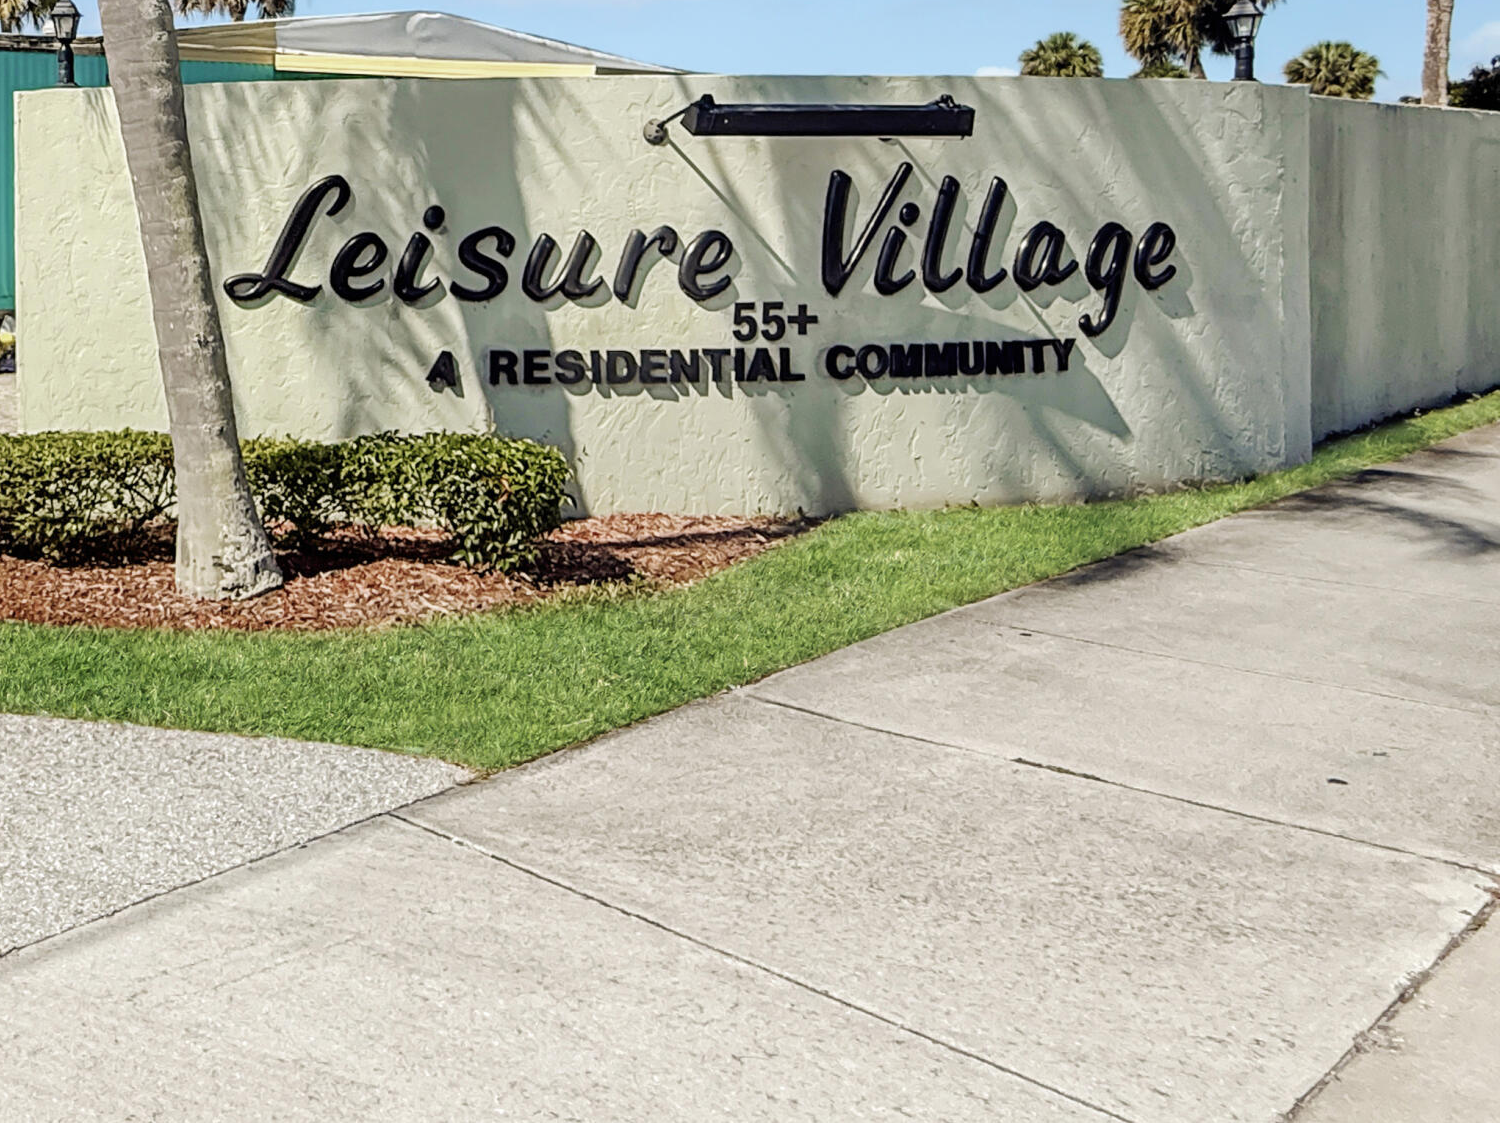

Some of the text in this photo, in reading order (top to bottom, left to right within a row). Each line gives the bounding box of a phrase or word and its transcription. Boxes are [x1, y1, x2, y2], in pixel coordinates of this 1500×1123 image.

[222, 161, 1177, 337] Leisure Village
[731, 301, 819, 343] 55+
[427, 337, 1077, 387] A RESIDENTIAL COMMUNITY
